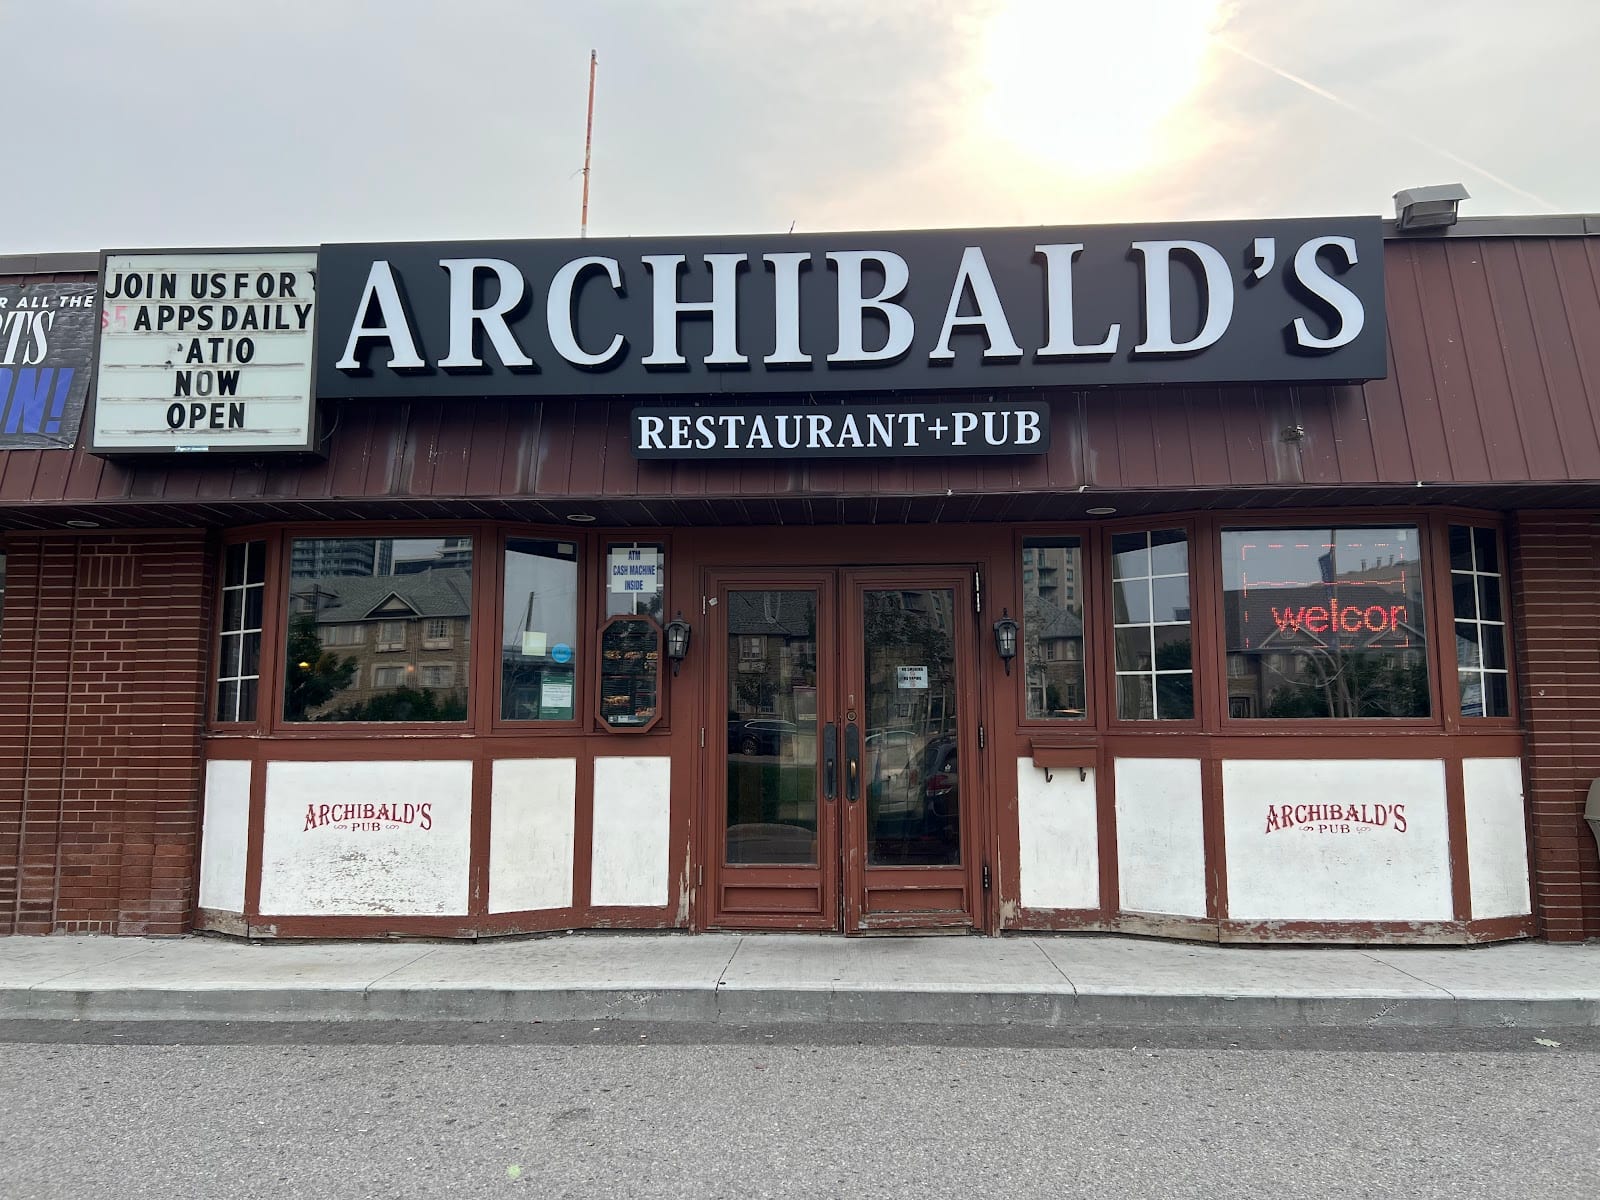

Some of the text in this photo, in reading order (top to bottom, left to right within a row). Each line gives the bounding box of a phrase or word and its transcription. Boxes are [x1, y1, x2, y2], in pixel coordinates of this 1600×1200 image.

[105, 272, 177, 299] JOIN
[16, 297, 50, 308] ALL
[59, 295, 94, 308] THE
[134, 304, 214, 331] APPS
[221, 303, 313, 331] DAILY
[177, 337, 255, 364] ATIO
[174, 370, 241, 397] NOW
[166, 402, 245, 429] OPEN
[628, 550, 641, 561] ATM
[612, 565, 656, 576] CASH MACHINE
[624, 580, 644, 591] INSIDE
[303, 803, 433, 832] ARCHIBALD'S
[352, 822, 381, 832] PUB
[1265, 804, 1407, 834] ARCHIBALD'S
[1319, 824, 1351, 834] PUB
